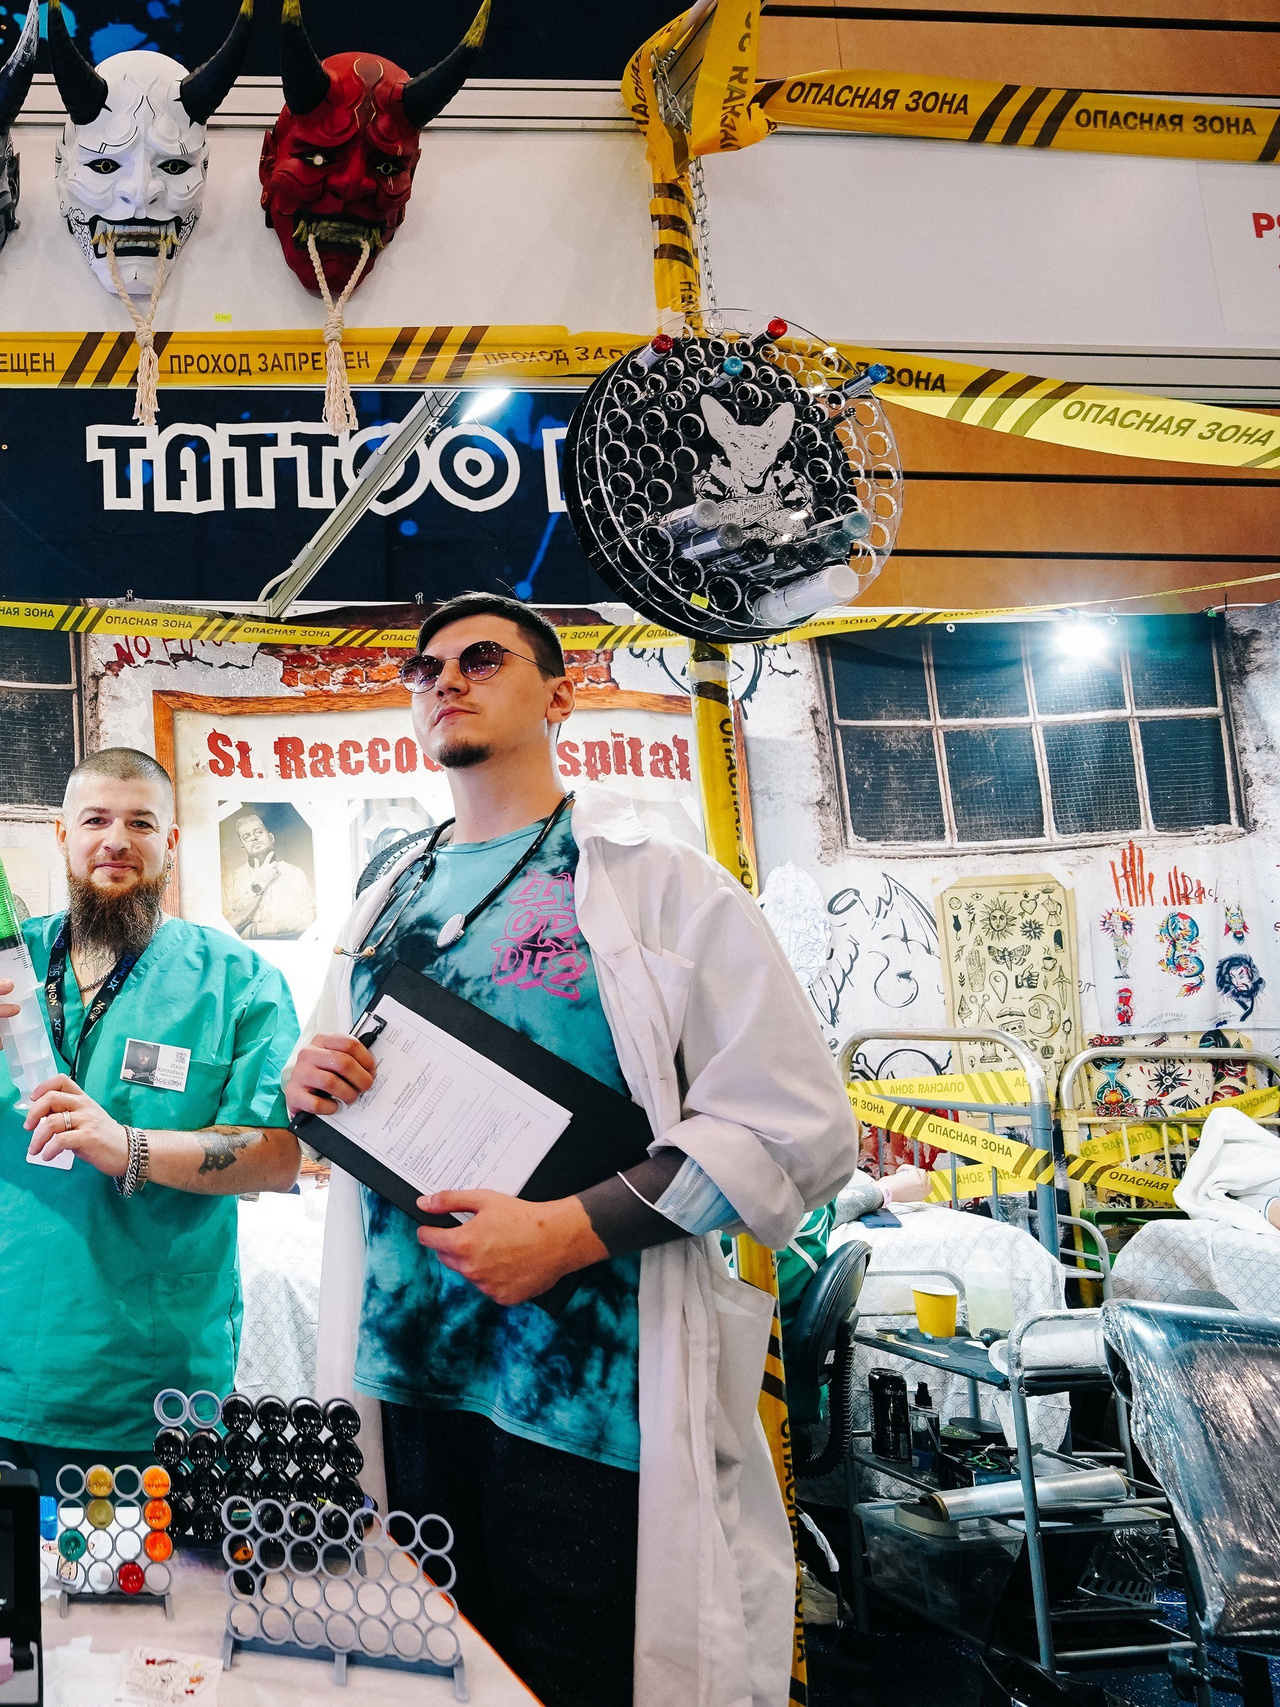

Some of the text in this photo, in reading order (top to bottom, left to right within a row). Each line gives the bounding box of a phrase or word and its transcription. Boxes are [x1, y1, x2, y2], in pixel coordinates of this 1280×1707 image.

[785, 80, 970, 115] ОПАСНАЯ ЗОНА
[1074, 108, 1258, 137] ОПАСНАЯ ЗОНА
[169, 349, 371, 377] ПРОХОД ЗАПРЕЕН
[1062, 400, 1276, 447] ОПАСНАЯ ЗОНА
[86, 420, 521, 515] TATTOO
[23, 607, 55, 619] ЗОНА
[105, 614, 193, 630] ОПАСНАЯ ЗОНА
[839, 615, 878, 626] ЗОНА
[243, 626, 331, 639] ОПАСНАЯ ЗОНА
[569, 630, 600, 640] ЗОНА
[860, 1101, 885, 1116] ЗОНА
[927, 1122, 1013, 1158] ОПАСНАЯ ЗОНА
[1109, 1170, 1170, 1192] ОПАСНАЯ
